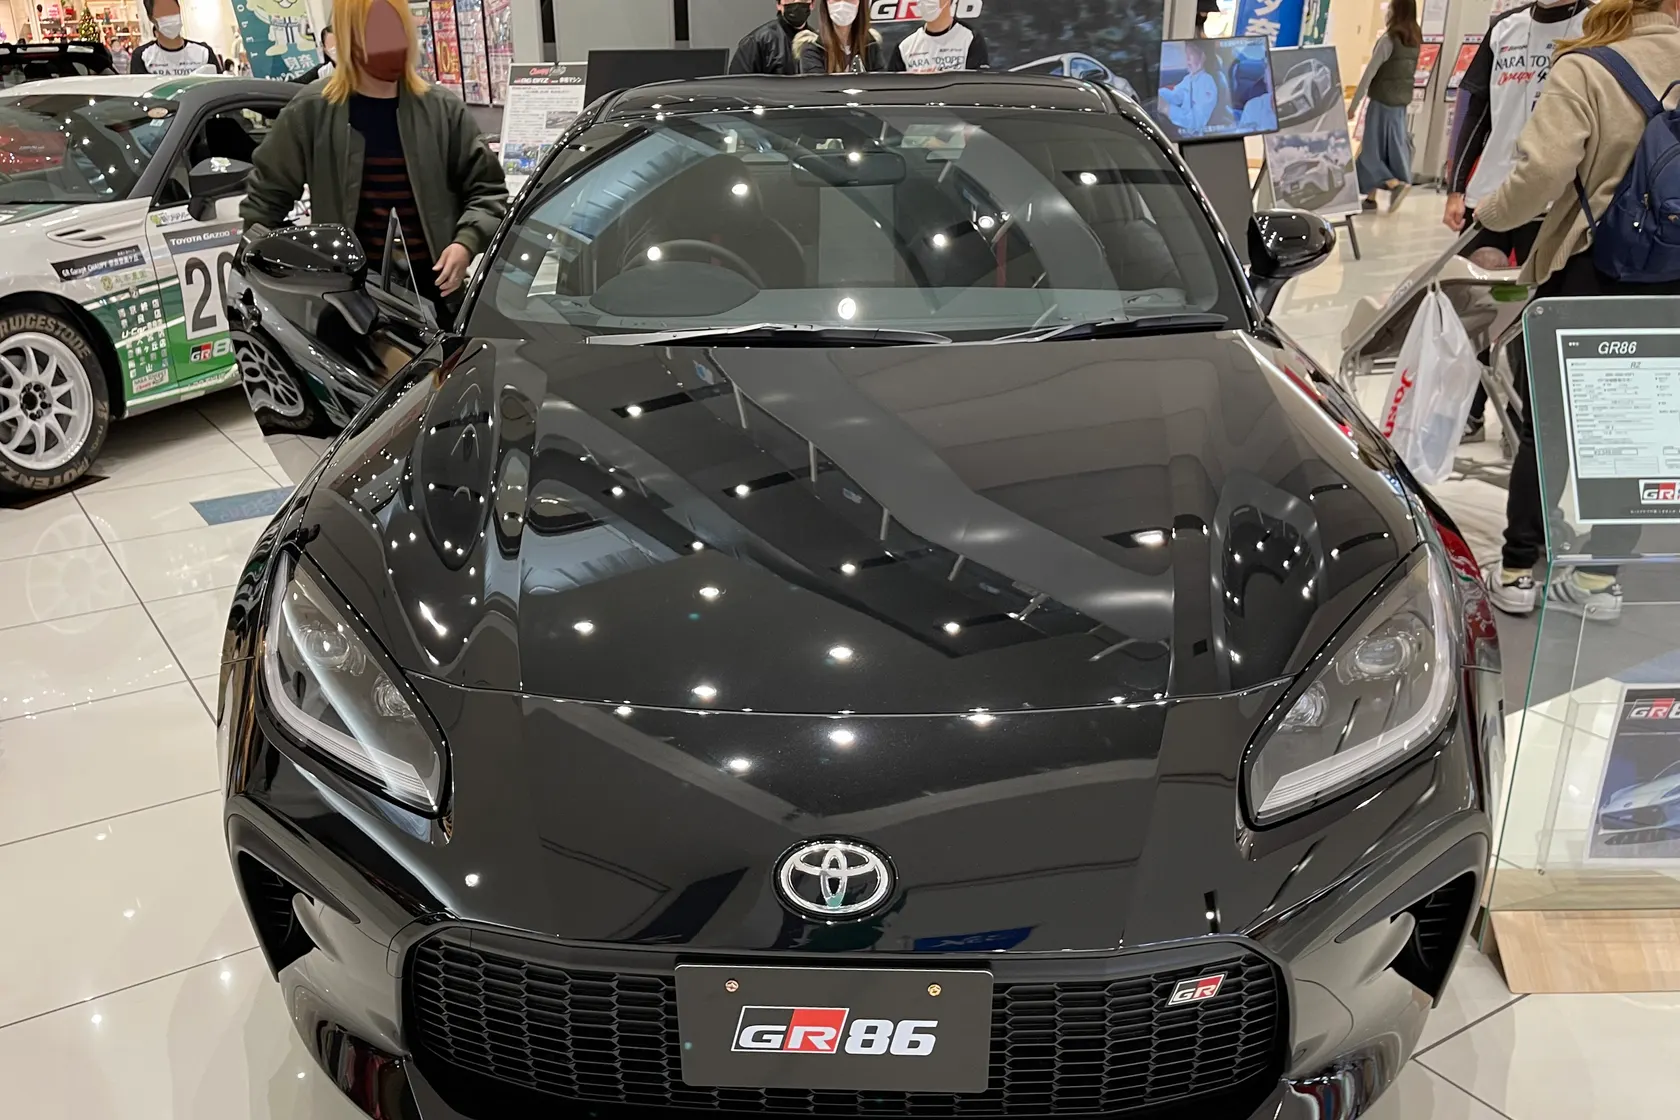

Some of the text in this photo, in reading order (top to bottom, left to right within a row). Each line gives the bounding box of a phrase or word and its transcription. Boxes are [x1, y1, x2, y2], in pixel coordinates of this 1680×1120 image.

[869, 0, 983, 19] GR6
[1494, 55, 1526, 71] NARA
[169, 235, 202, 246] TOYOTA
[202, 231, 230, 241] GAZOO
[190, 338, 235, 363] GR8
[1597, 341, 1638, 355] GR86
[1642, 488, 1676, 501] GR
[1171, 983, 1218, 1003] GR
